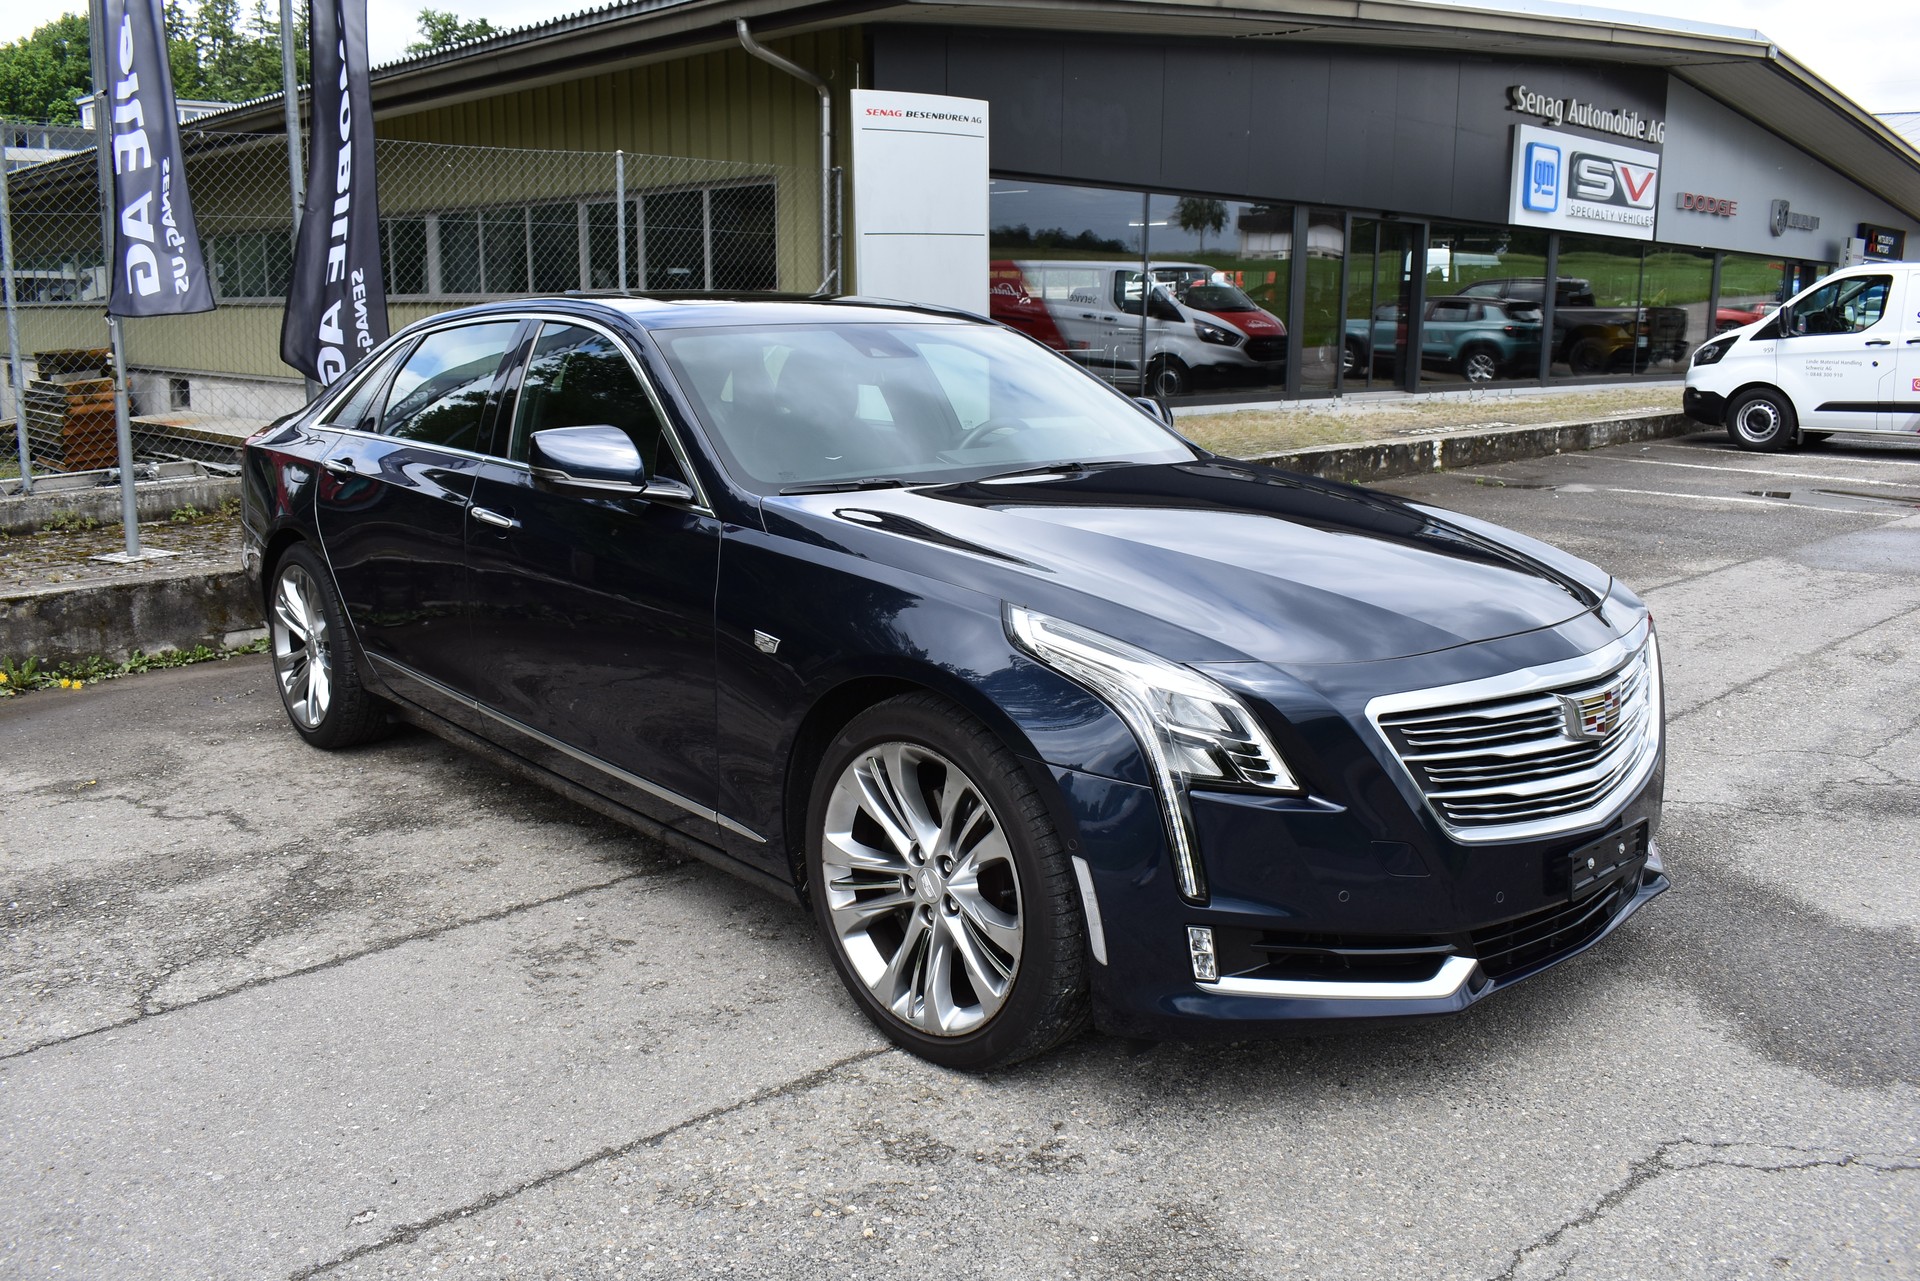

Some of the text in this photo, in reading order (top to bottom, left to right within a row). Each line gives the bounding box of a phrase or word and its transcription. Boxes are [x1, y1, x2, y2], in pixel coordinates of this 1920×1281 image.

[865, 108, 983, 124] SENAG BESENBÜREN AG
[1517, 85, 1665, 144] Senag Automobile AG
[1534, 159, 1556, 195] gm
[1576, 158, 1655, 202] SV
[1570, 204, 1654, 226] SPECIALTY VEHICLES
[1683, 192, 1738, 216] DODGE
